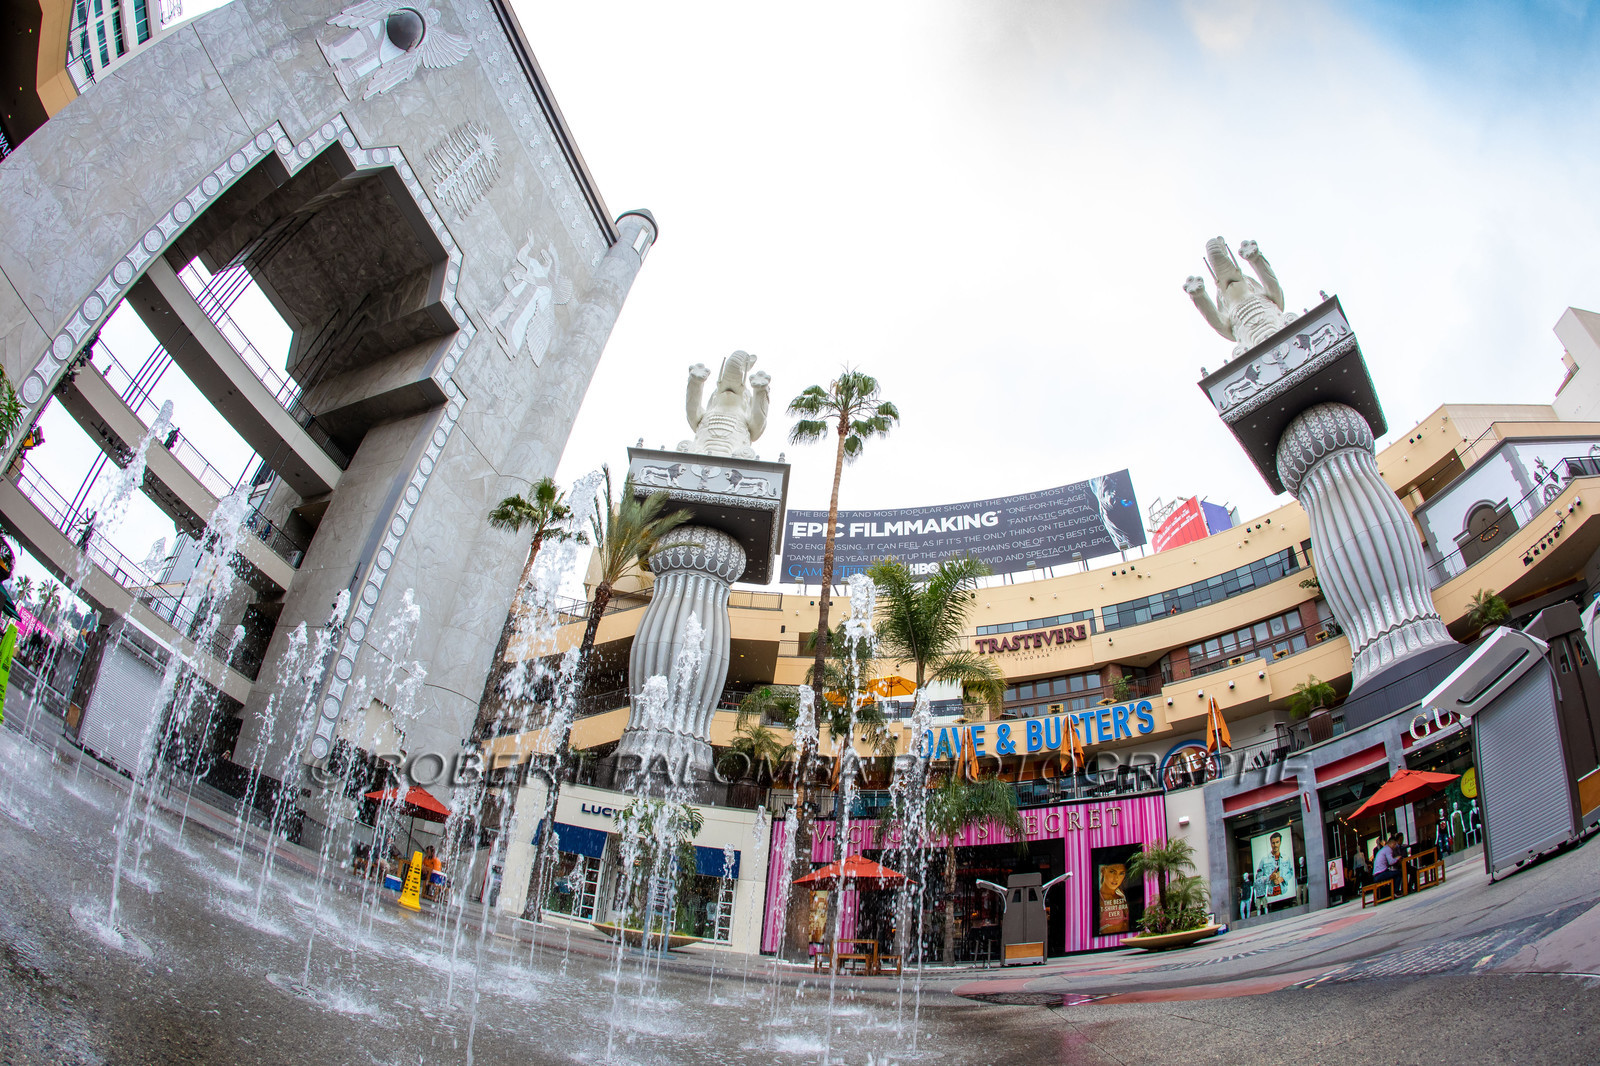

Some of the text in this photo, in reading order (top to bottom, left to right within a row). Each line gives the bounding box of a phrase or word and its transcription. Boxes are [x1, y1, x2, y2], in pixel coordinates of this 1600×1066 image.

[900, 507, 942, 516] POPULAR
[944, 503, 971, 512] SHOW
[984, 499, 1002, 507] THE
[898, 541, 921, 549] FEEL
[936, 538, 944, 546] IF
[946, 537, 962, 545] IT'S
[964, 534, 981, 543] THE
[983, 531, 1007, 541] ONLY
[1009, 526, 1036, 537] THING
[1053, 514, 1100, 529] TELEVISION
[1012, 539, 1031, 548] ONE
[1032, 536, 1044, 545] OF
[1046, 533, 1065, 542] TV'S
[1066, 529, 1087, 539] BEST
[907, 552, 920, 560] UP
[920, 551, 937, 559] THE
[1005, 552, 1024, 561] AND
[788, 564, 823, 578] GAM
[910, 562, 940, 576] HBO
[975, 623, 1088, 655] TRASTEVERE
[1041, 643, 1077, 653] PIZZERIA
[996, 723, 1017, 756] &
